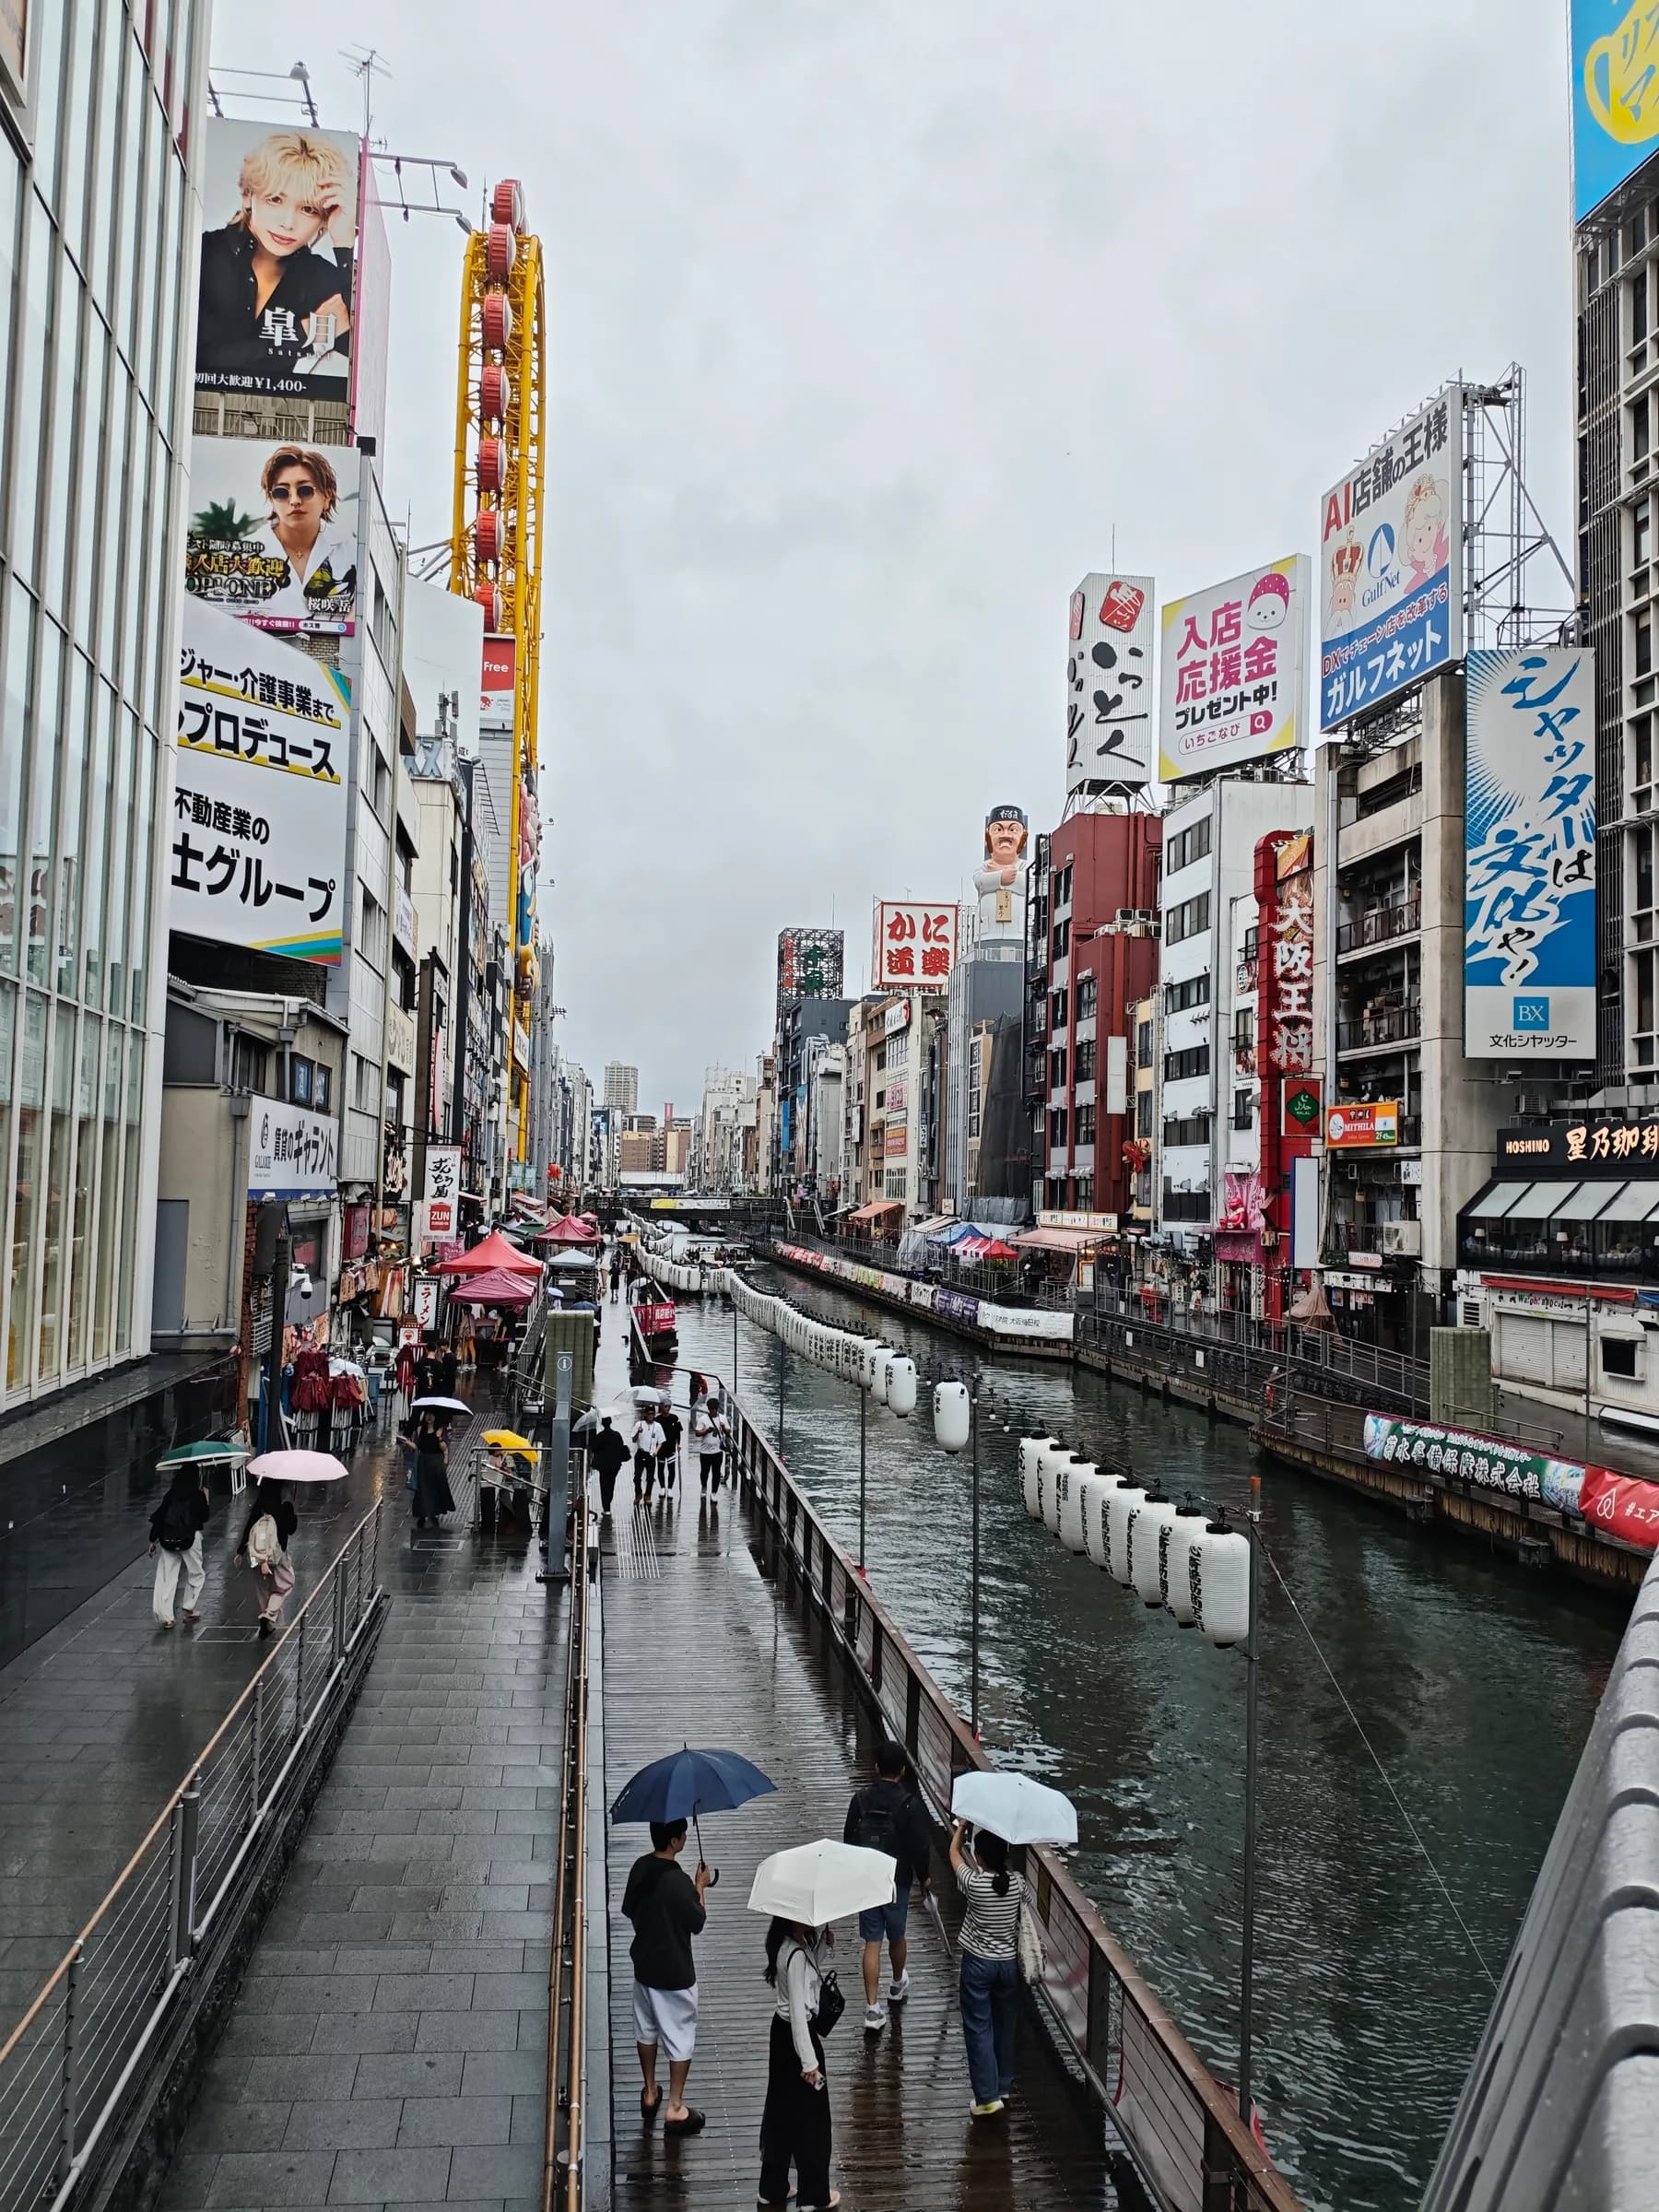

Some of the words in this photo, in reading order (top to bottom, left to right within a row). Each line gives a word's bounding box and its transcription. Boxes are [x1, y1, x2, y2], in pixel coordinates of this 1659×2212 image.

[1324, 402, 1448, 542] AI店舗の王様
[1177, 600, 1242, 661] 入店
[1322, 582, 1448, 677] DXでチェーン店を改革する
[484, 661, 509, 673] Free
[1176, 636, 1277, 705] 応援金
[1327, 619, 1441, 718] ガルフネット
[1175, 680, 1277, 731] プレゼント中!
[178, 700, 335, 779] プロデュース
[1184, 723, 1241, 750] いちごなび
[174, 786, 270, 845] 不動産業の
[887, 911, 950, 944] かに
[1268, 896, 1314, 1072] 大阪王将
[1518, 1005, 1546, 1022] BX
[1344, 1122, 1375, 1132] MITHILA
[1505, 1139, 1550, 1154] HOSHINO
[430, 1210, 450, 1221] ZUN
[421, 1287, 431, 1328] ラーメン
